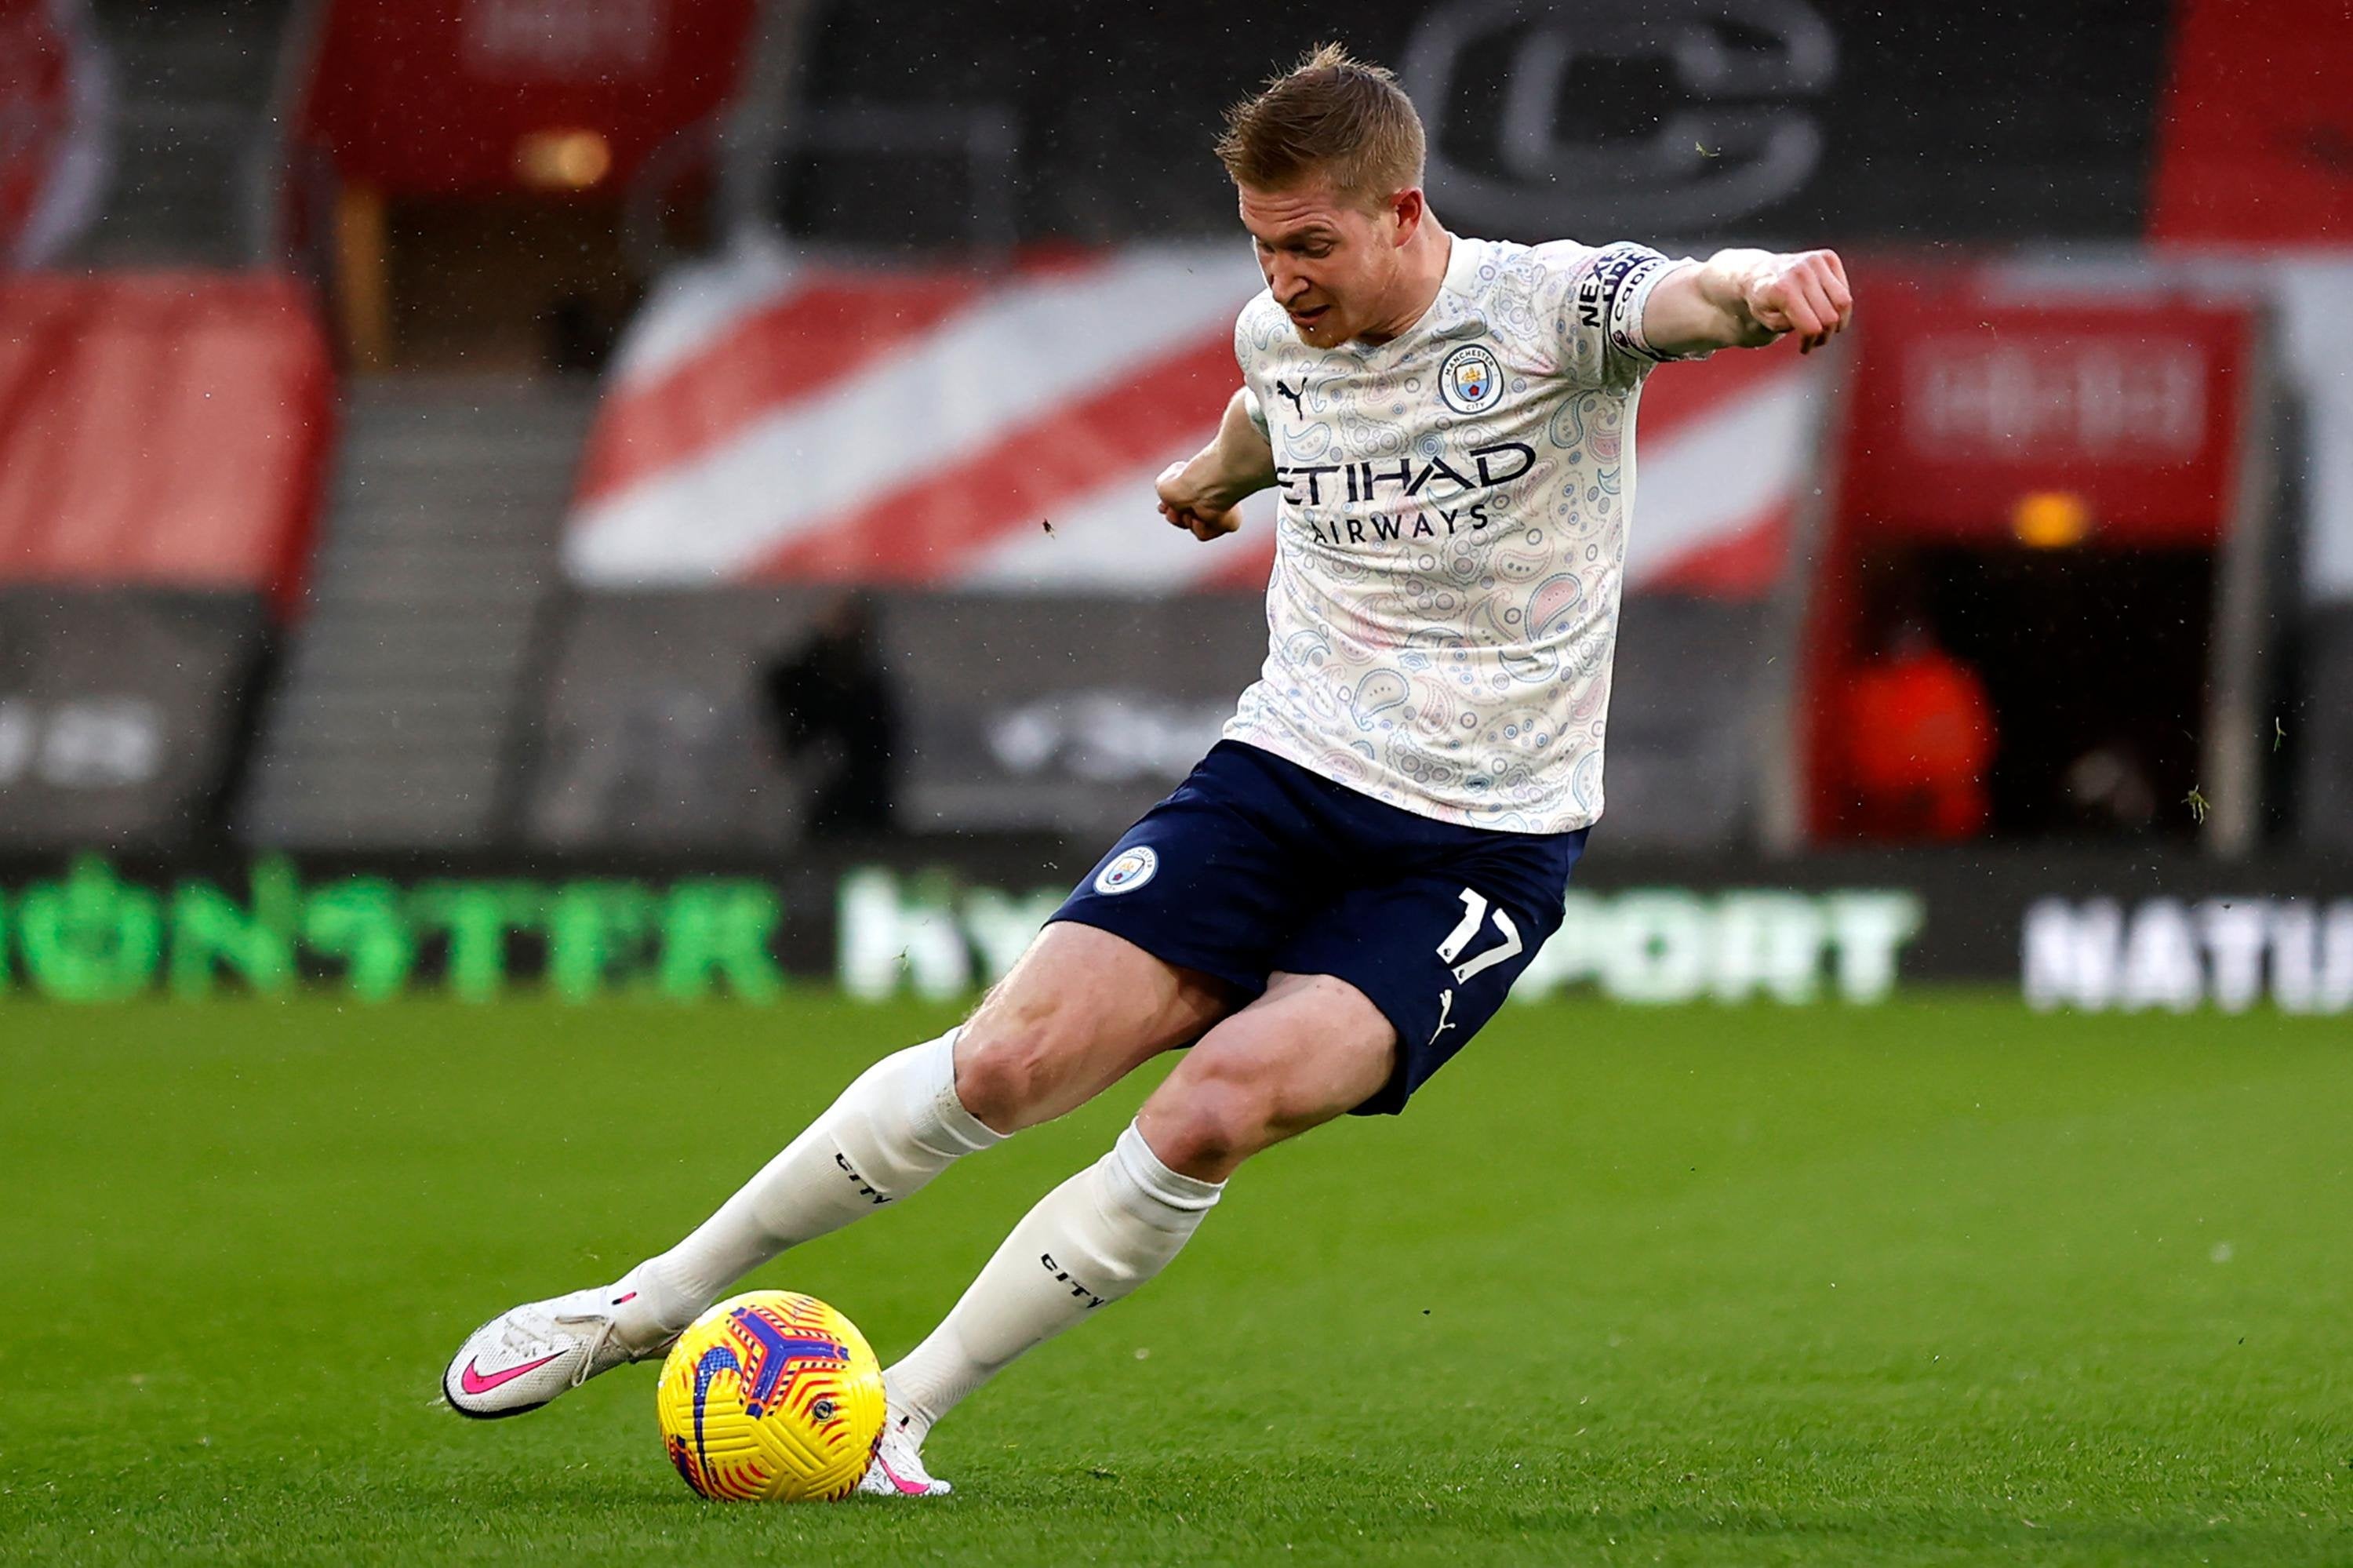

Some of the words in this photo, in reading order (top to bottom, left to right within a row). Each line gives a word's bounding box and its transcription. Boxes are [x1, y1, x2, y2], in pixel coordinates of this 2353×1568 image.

[1578, 248, 1633, 328] NEXE
[1446, 350, 1494, 376] MANCHESTER
[1466, 402, 1485, 410] CITY
[1276, 442, 1537, 506] ETIHAD
[1310, 504, 1489, 545] AIRWAYS
[0, 849, 780, 1004] ONSTER
[1507, 888, 1926, 1006] PORT
[1435, 886, 1523, 985] 17
[835, 1152, 893, 1204] CITY
[1041, 1253, 1105, 1308] CITY
